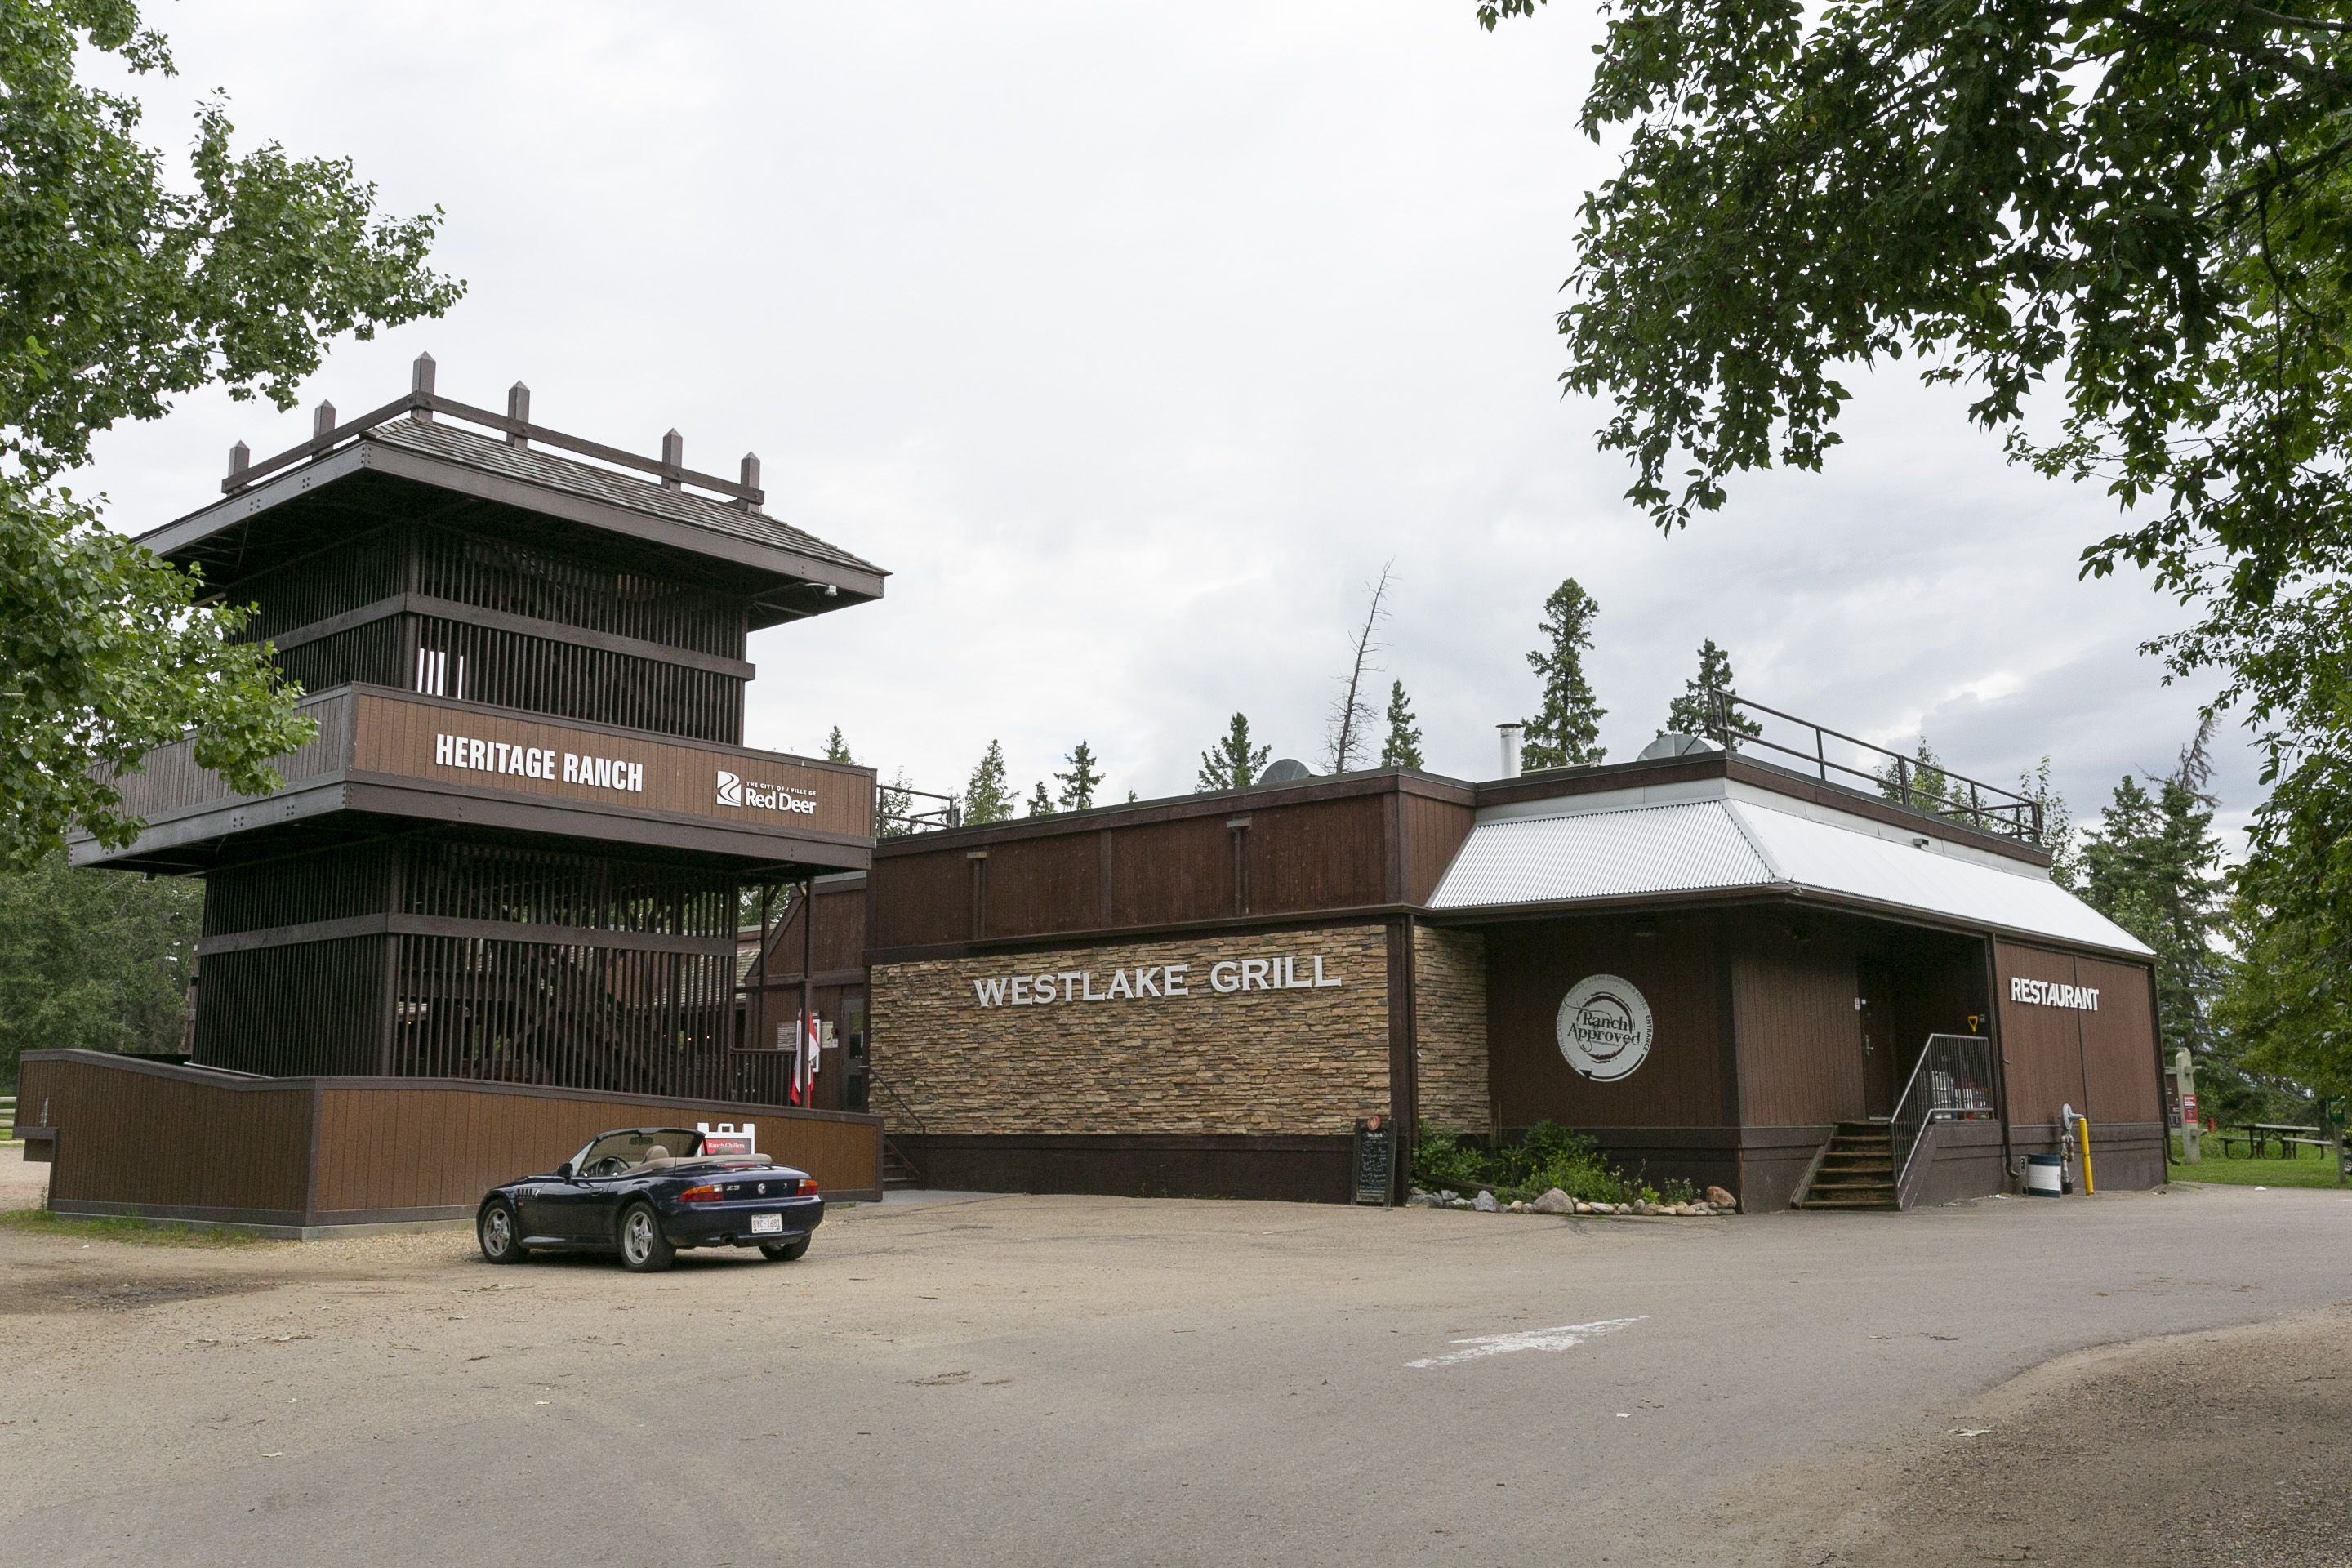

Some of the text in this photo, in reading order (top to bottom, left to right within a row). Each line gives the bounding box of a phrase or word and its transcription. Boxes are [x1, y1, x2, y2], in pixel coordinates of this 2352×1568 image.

[436, 733, 643, 791] HERITAGE RANCH
[746, 787, 817, 814] Red Deer
[973, 955, 1342, 1007] WESTLAKE GRILL
[2011, 977, 2099, 1010] RESTAURANT
[1557, 1004, 1566, 1036] CARRIAGE
[1588, 975, 1606, 983] STEAK
[1606, 975, 1632, 989] DINNERS
[1635, 992, 1648, 1010] MORE
[1643, 1014, 1653, 1052] ENTRANCE
[1582, 1012, 1628, 1031] Ranch
[1567, 1023, 1642, 1045] Approved
